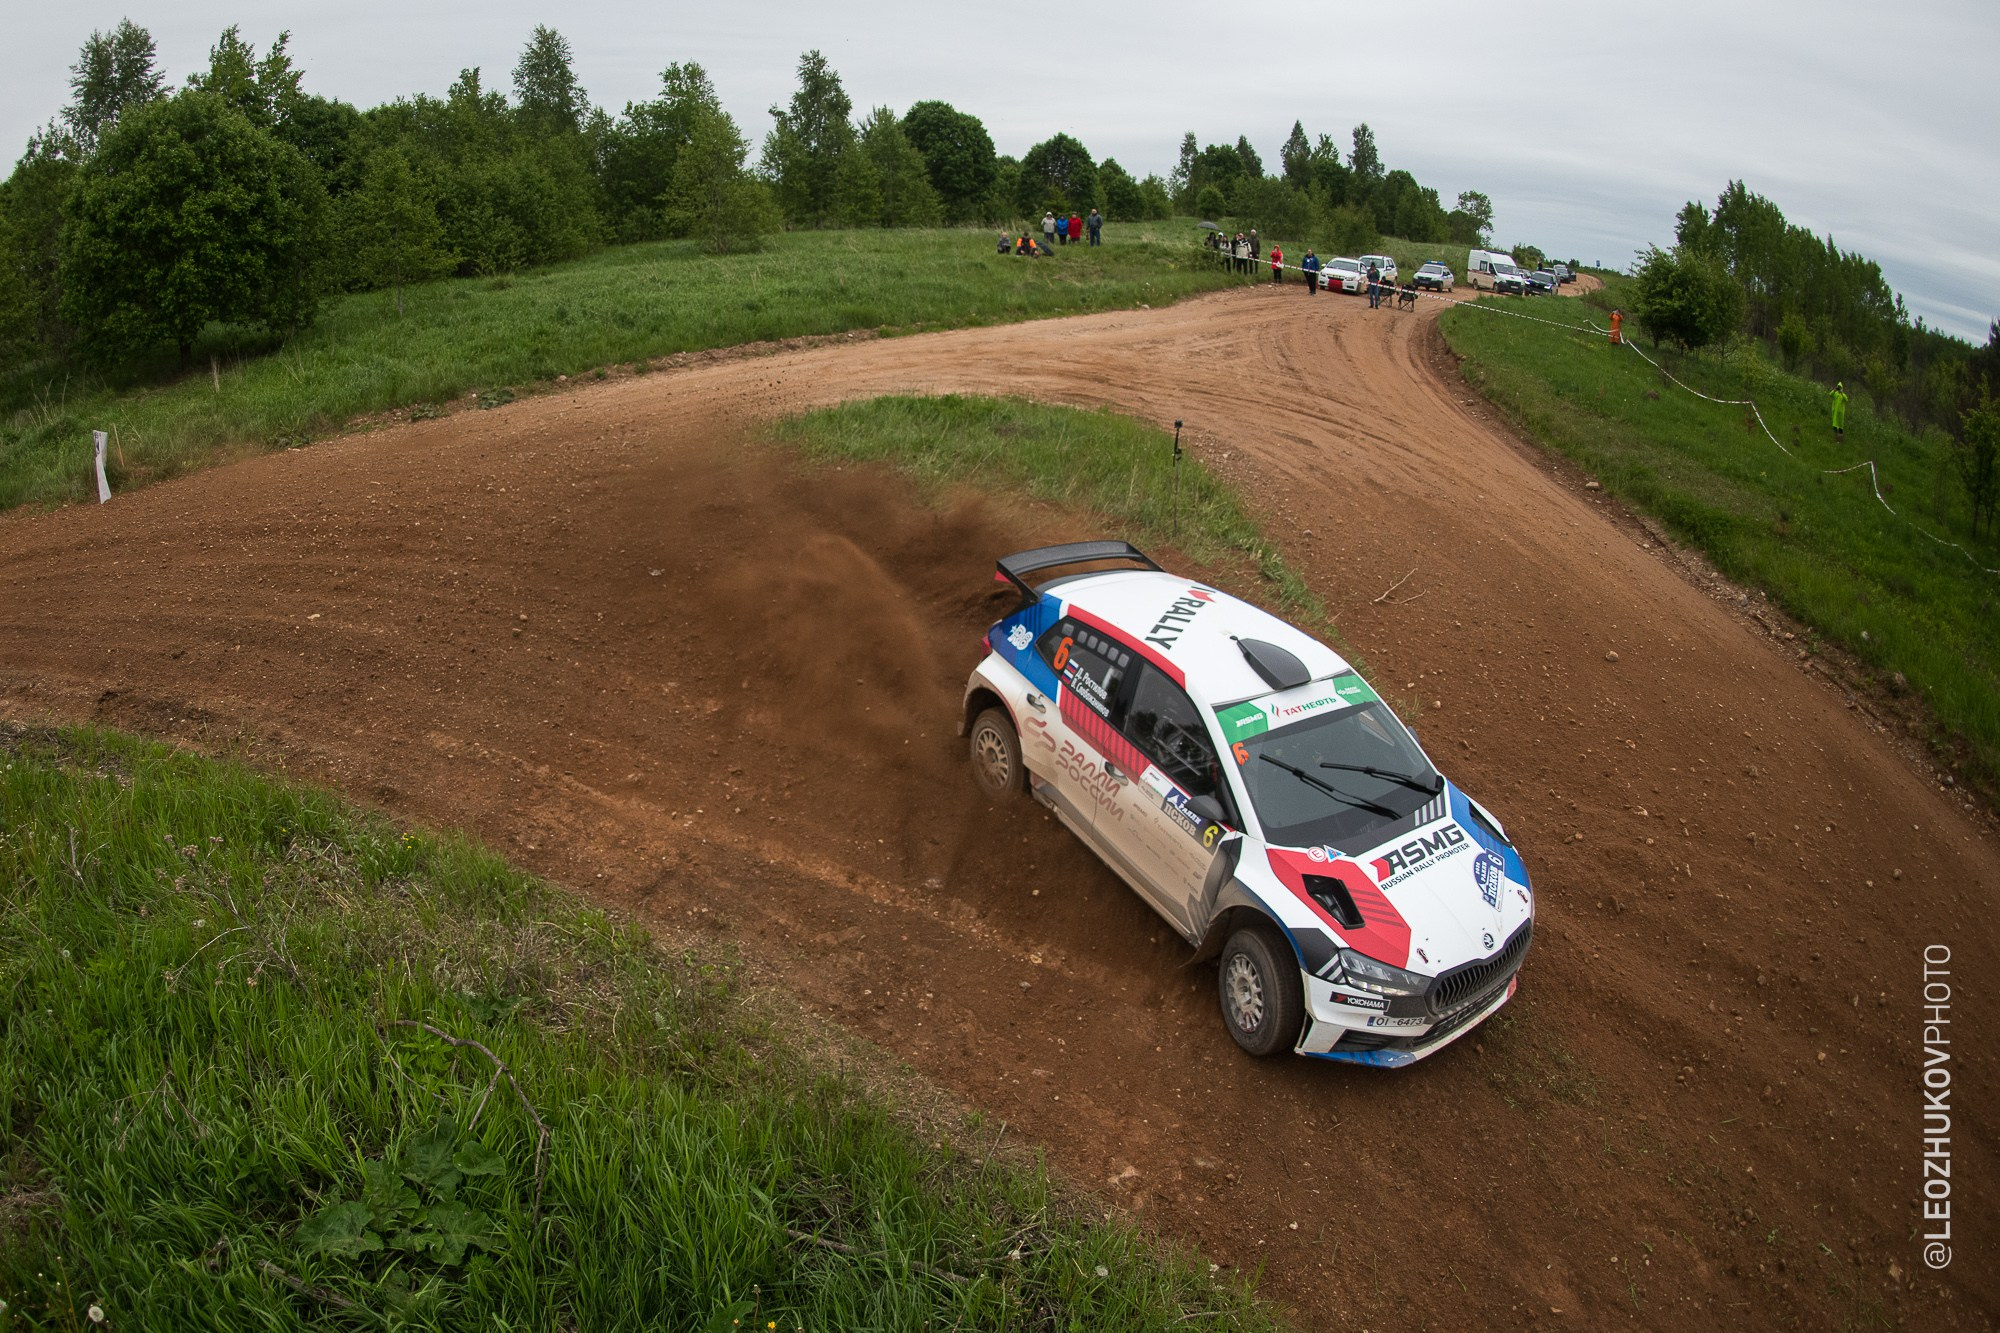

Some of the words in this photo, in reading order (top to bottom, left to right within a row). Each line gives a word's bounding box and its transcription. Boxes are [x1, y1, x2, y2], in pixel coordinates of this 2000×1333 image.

[1145, 597, 1206, 650] RALLY
[1053, 636, 1074, 670] 6
[1283, 697, 1336, 716] ТАТНЕФТЬ
[1232, 741, 1249, 766] 6
[1164, 804, 1197, 836] ПСКОВ
[1203, 825, 1219, 848] 6
[1378, 823, 1465, 878] ASMG
[1380, 869, 1415, 891] RUSSIAN
[1413, 858, 1436, 873] RALLY
[1435, 843, 1470, 861] PROMOTER
[1487, 854, 1503, 866] 6
[1488, 865, 1498, 899] ПСКОВ
[1347, 996, 1385, 1009] YOKOHAMA
